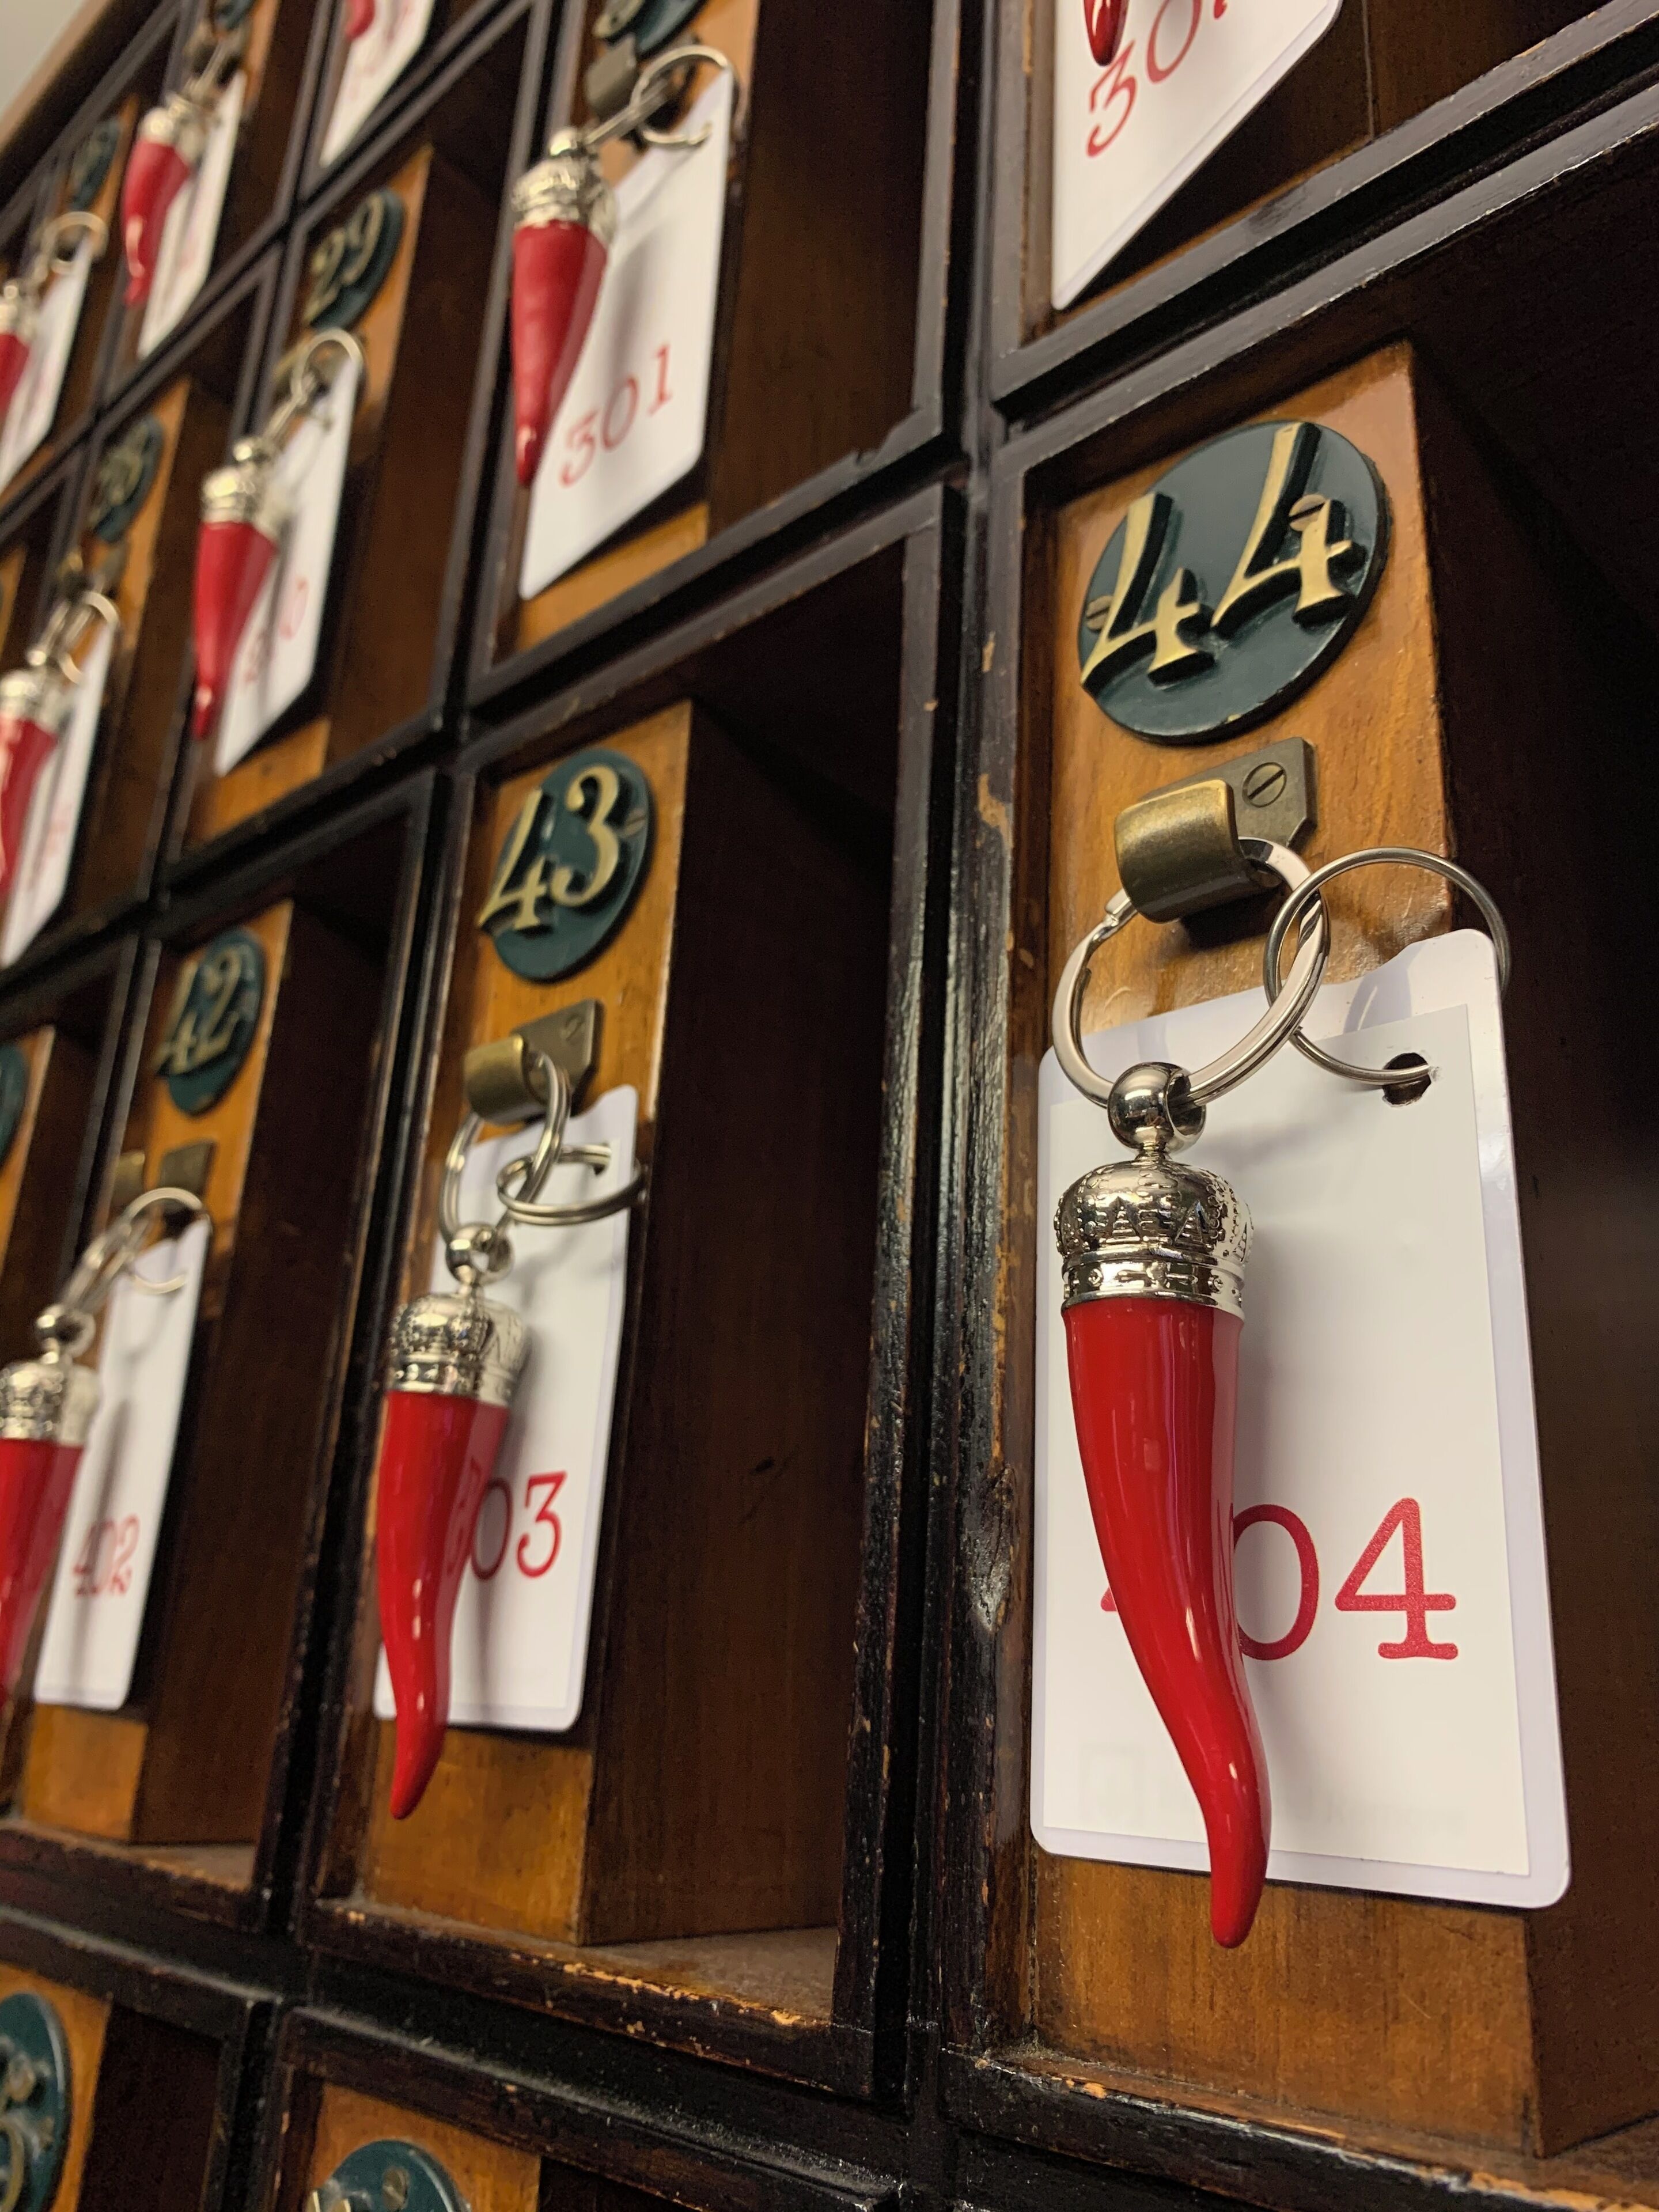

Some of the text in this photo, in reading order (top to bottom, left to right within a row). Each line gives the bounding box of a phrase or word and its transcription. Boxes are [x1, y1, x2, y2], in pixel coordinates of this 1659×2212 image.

[1086, 0, 1228, 157] 30
[1081, 421, 1355, 679] 44
[478, 764, 620, 930] 43
[151, 946, 244, 1074] 42
[470, 1470, 568, 1581] 03
[1100, 1496, 1459, 1661] 04
